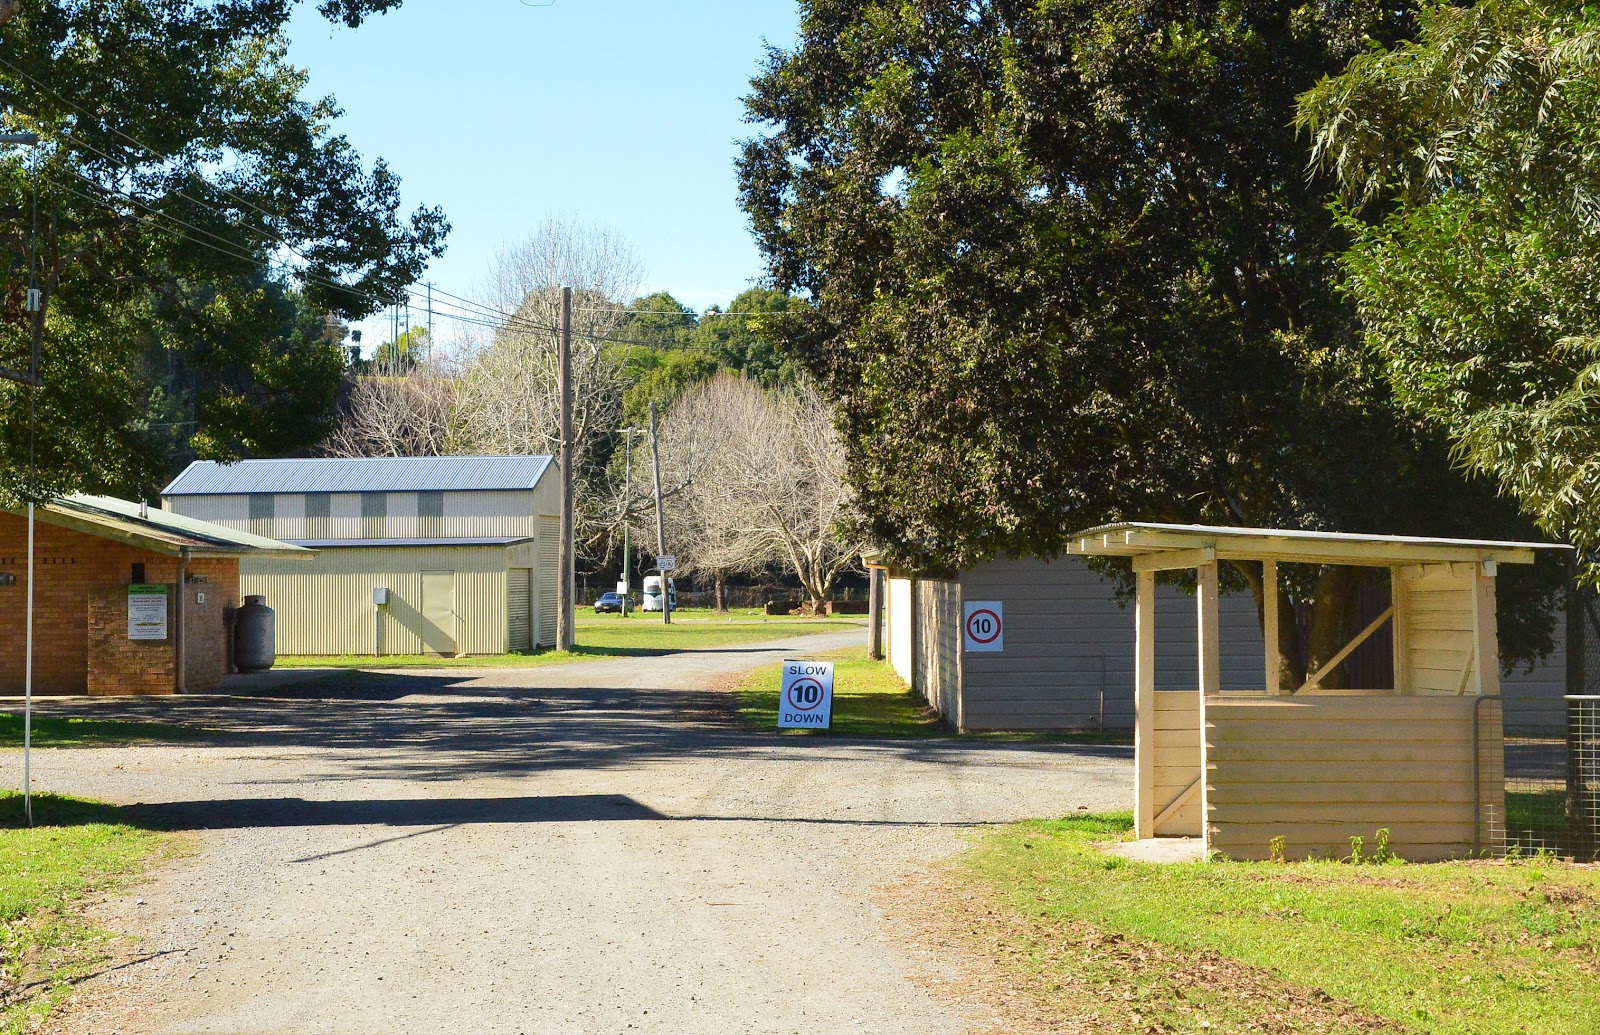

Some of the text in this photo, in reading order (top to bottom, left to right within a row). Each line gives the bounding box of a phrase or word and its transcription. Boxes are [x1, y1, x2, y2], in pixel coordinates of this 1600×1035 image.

[973, 619, 991, 634] 10
[789, 665, 827, 675] SLOW
[793, 685, 818, 703] 10
[784, 713, 824, 723] DOWN
